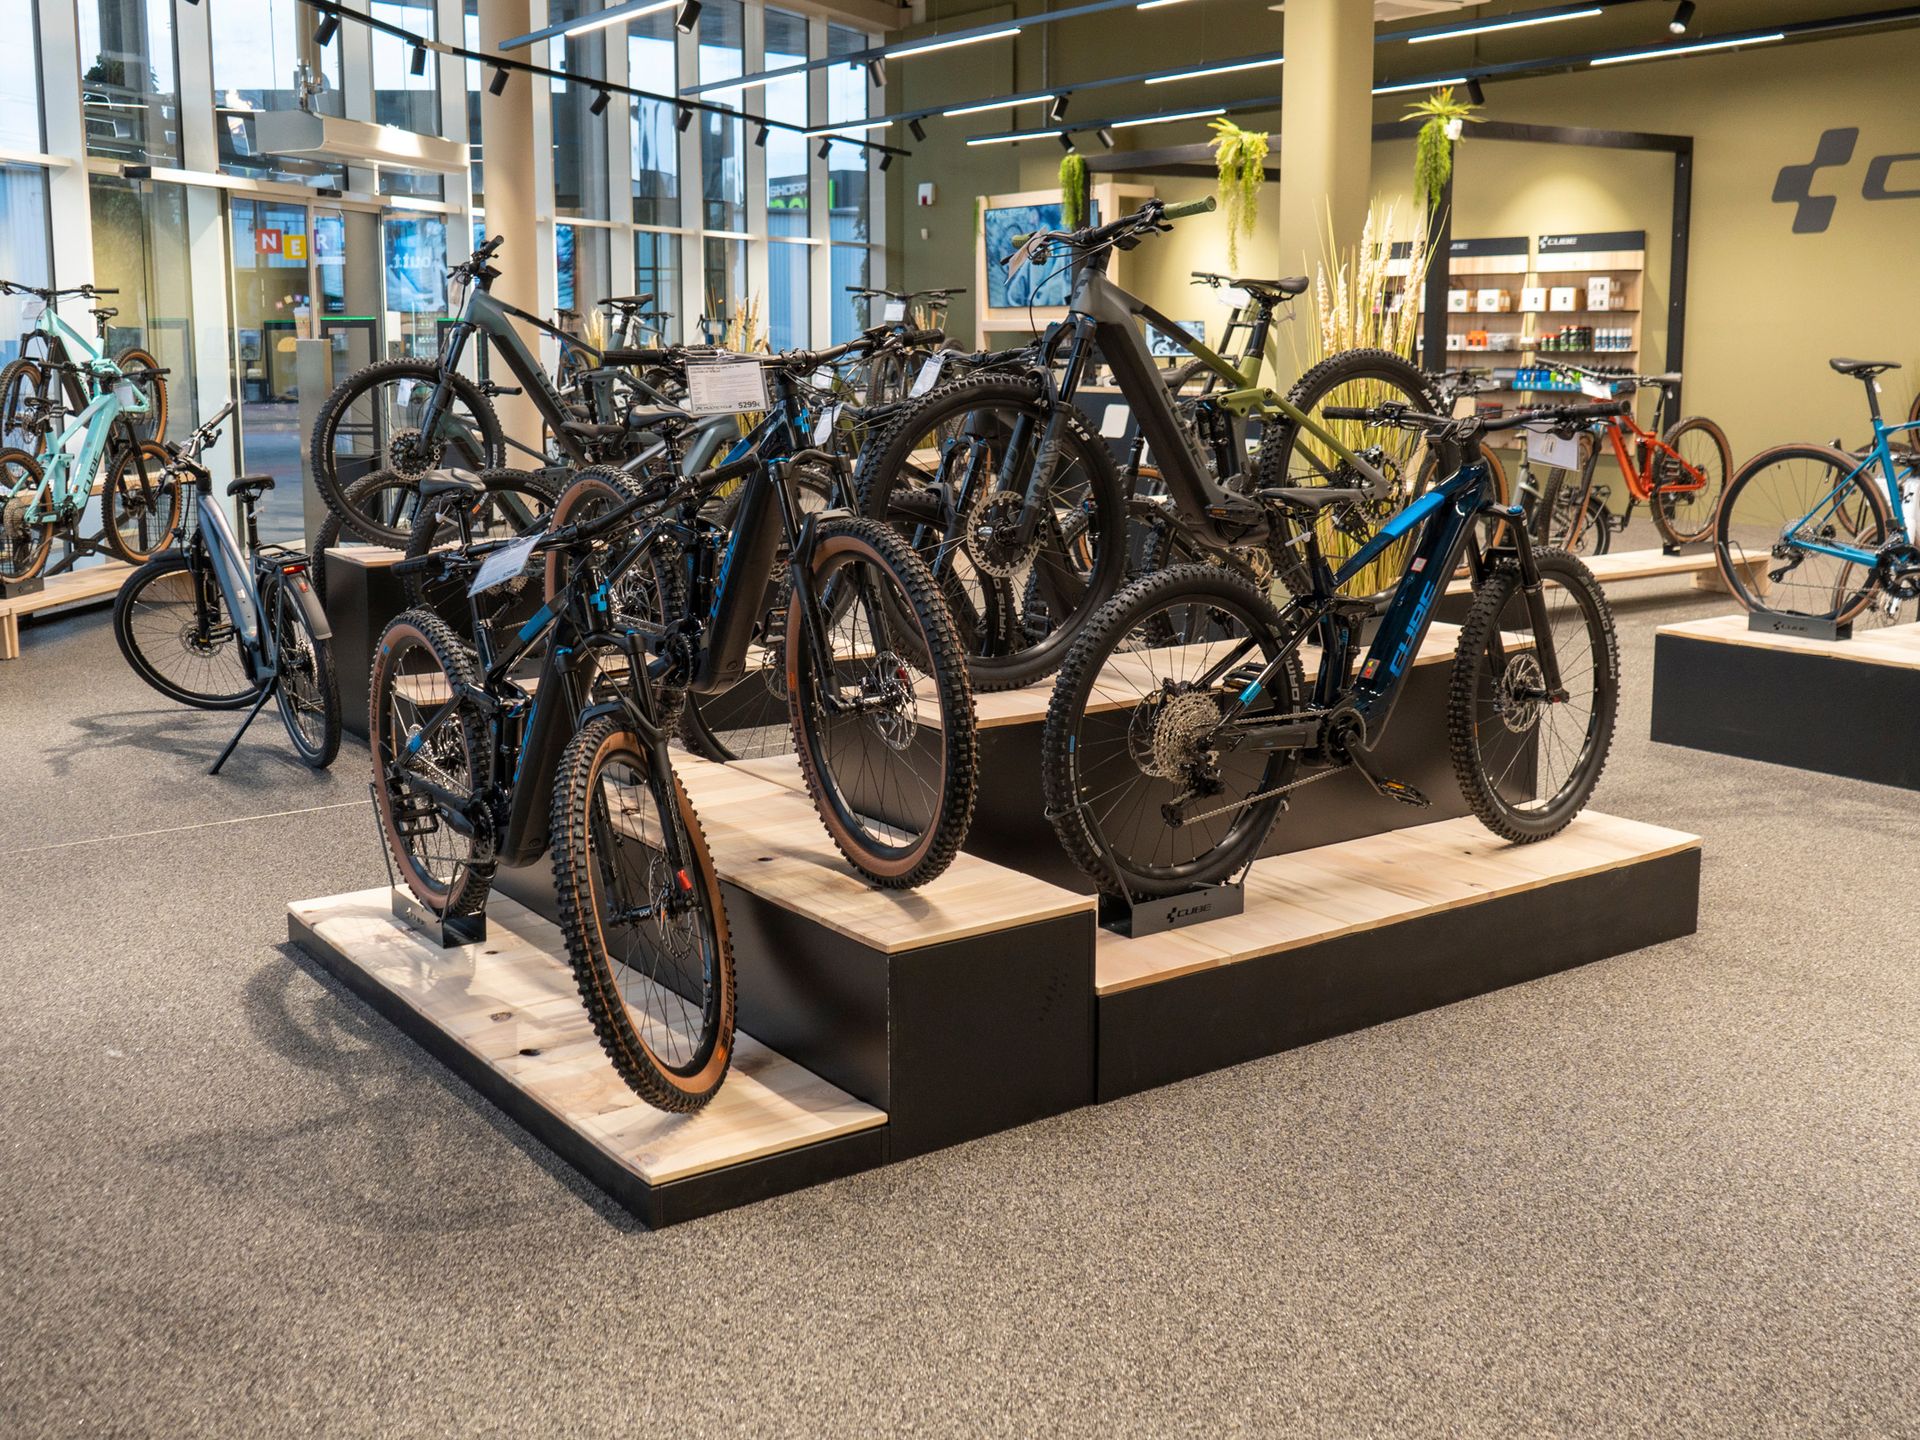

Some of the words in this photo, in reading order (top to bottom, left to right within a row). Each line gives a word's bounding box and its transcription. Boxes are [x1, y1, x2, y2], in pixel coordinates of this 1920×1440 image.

[769, 183, 807, 197] SHOPP
[1547, 237, 1577, 246] CUBE
[1421, 388, 1444, 416] MAX
[1162, 387, 1204, 469] CUBE
[997, 592, 1007, 641] HANS
[1389, 580, 1435, 677] CUBE
[1585, 584, 1610, 631] DAMPF
[1605, 633, 1617, 680] HANS
[1177, 903, 1212, 918] CUBE
[721, 940, 734, 1049] SCHWALBE
